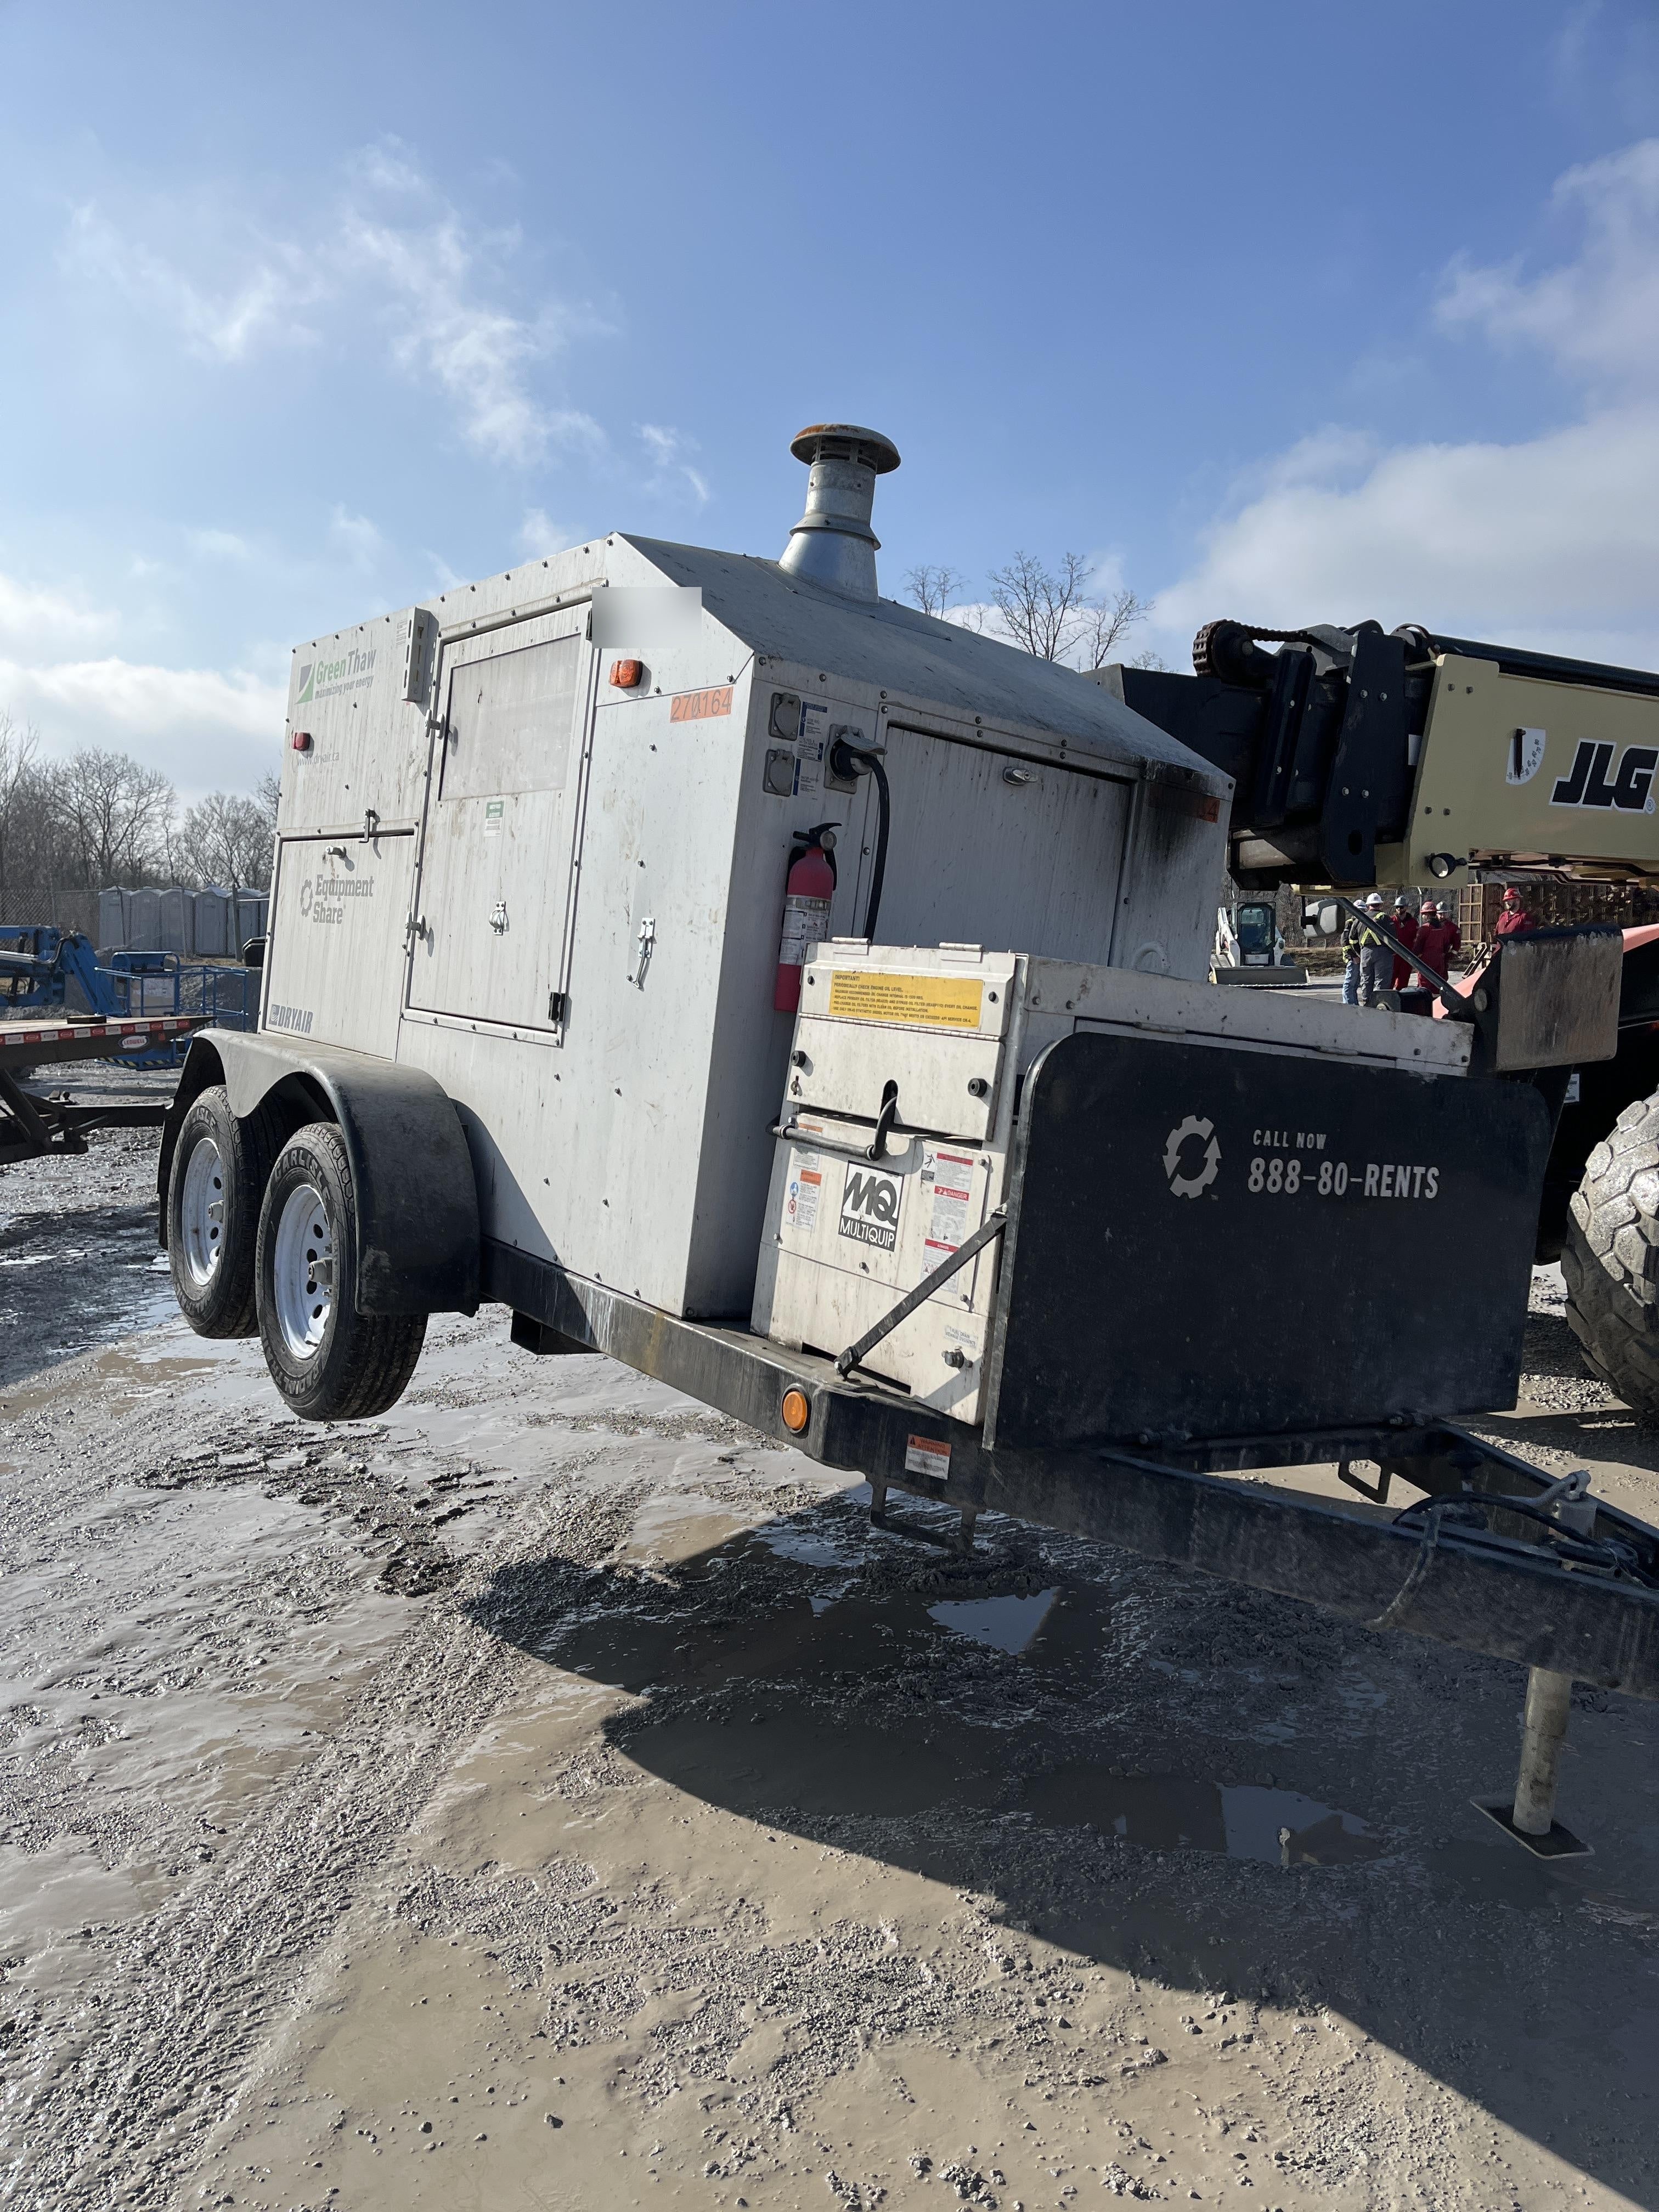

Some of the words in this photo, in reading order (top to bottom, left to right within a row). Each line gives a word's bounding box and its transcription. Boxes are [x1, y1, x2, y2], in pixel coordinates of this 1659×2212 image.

[343, 682, 354, 695] your
[356, 675, 374, 689] energy
[670, 687, 732, 721] 270164
[1551, 740, 1659, 810] JLG
[315, 874, 374, 901] Equipment
[313, 901, 343, 924] Share
[278, 1006, 313, 1034] DRYAIR
[1253, 1129, 1289, 1148] CALL
[1296, 1132, 1327, 1150] NOW
[274, 1149, 331, 1201] CARLISLE
[1247, 1157, 1440, 1199] 888-80-RENTS
[842, 1172, 898, 1227] MQ
[947, 1190, 968, 1200] DANGER
[839, 1217, 895, 1248] MULTIQUIP
